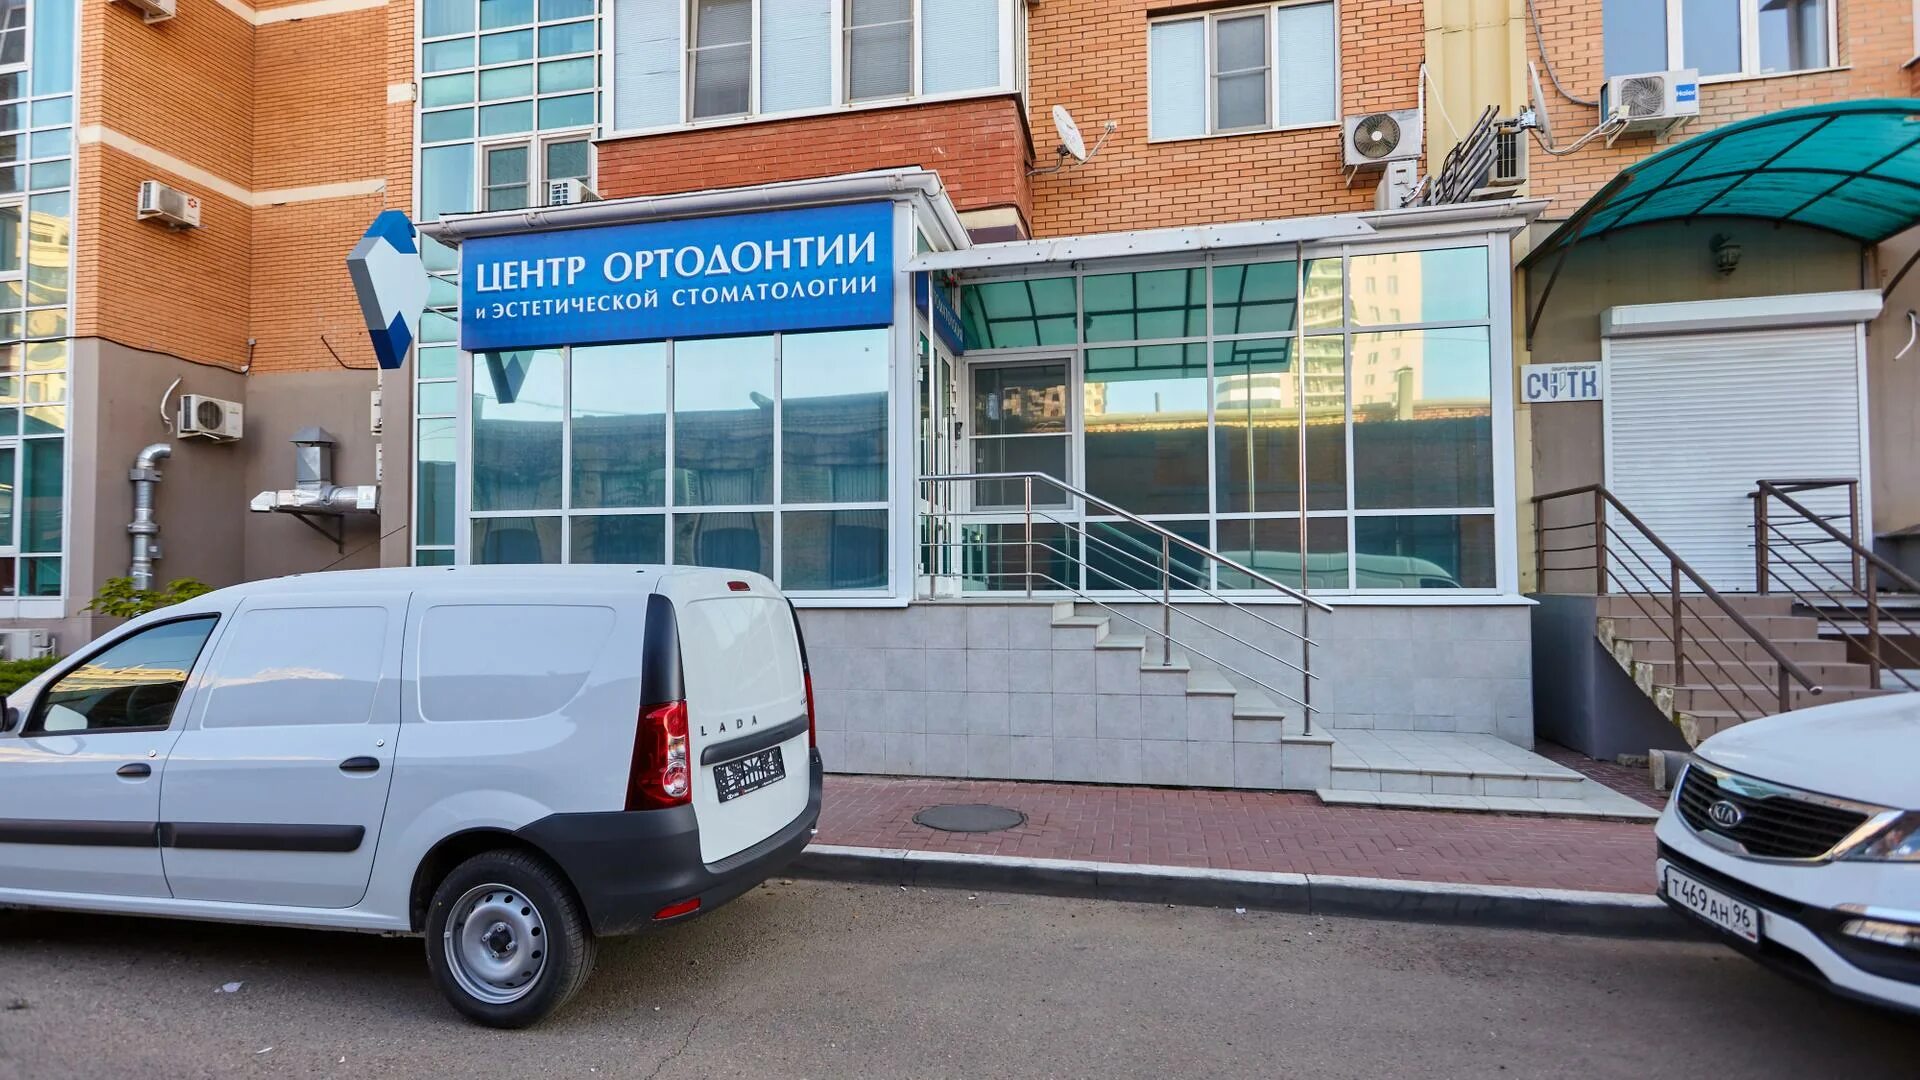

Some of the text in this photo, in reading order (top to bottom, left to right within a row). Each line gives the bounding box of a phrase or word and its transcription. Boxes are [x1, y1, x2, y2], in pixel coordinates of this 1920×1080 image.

[476, 232, 876, 294] ЦЕНТР ОРТОДОНТИИ
[492, 289, 658, 319] ЭСТЕТИЧЕСКОЙ
[672, 275, 877, 307] СТОМАТОЛОГИИ
[700, 715, 758, 736] LADA
[1711, 803, 1735, 824] KIA
[1733, 903, 1751, 928] 96
